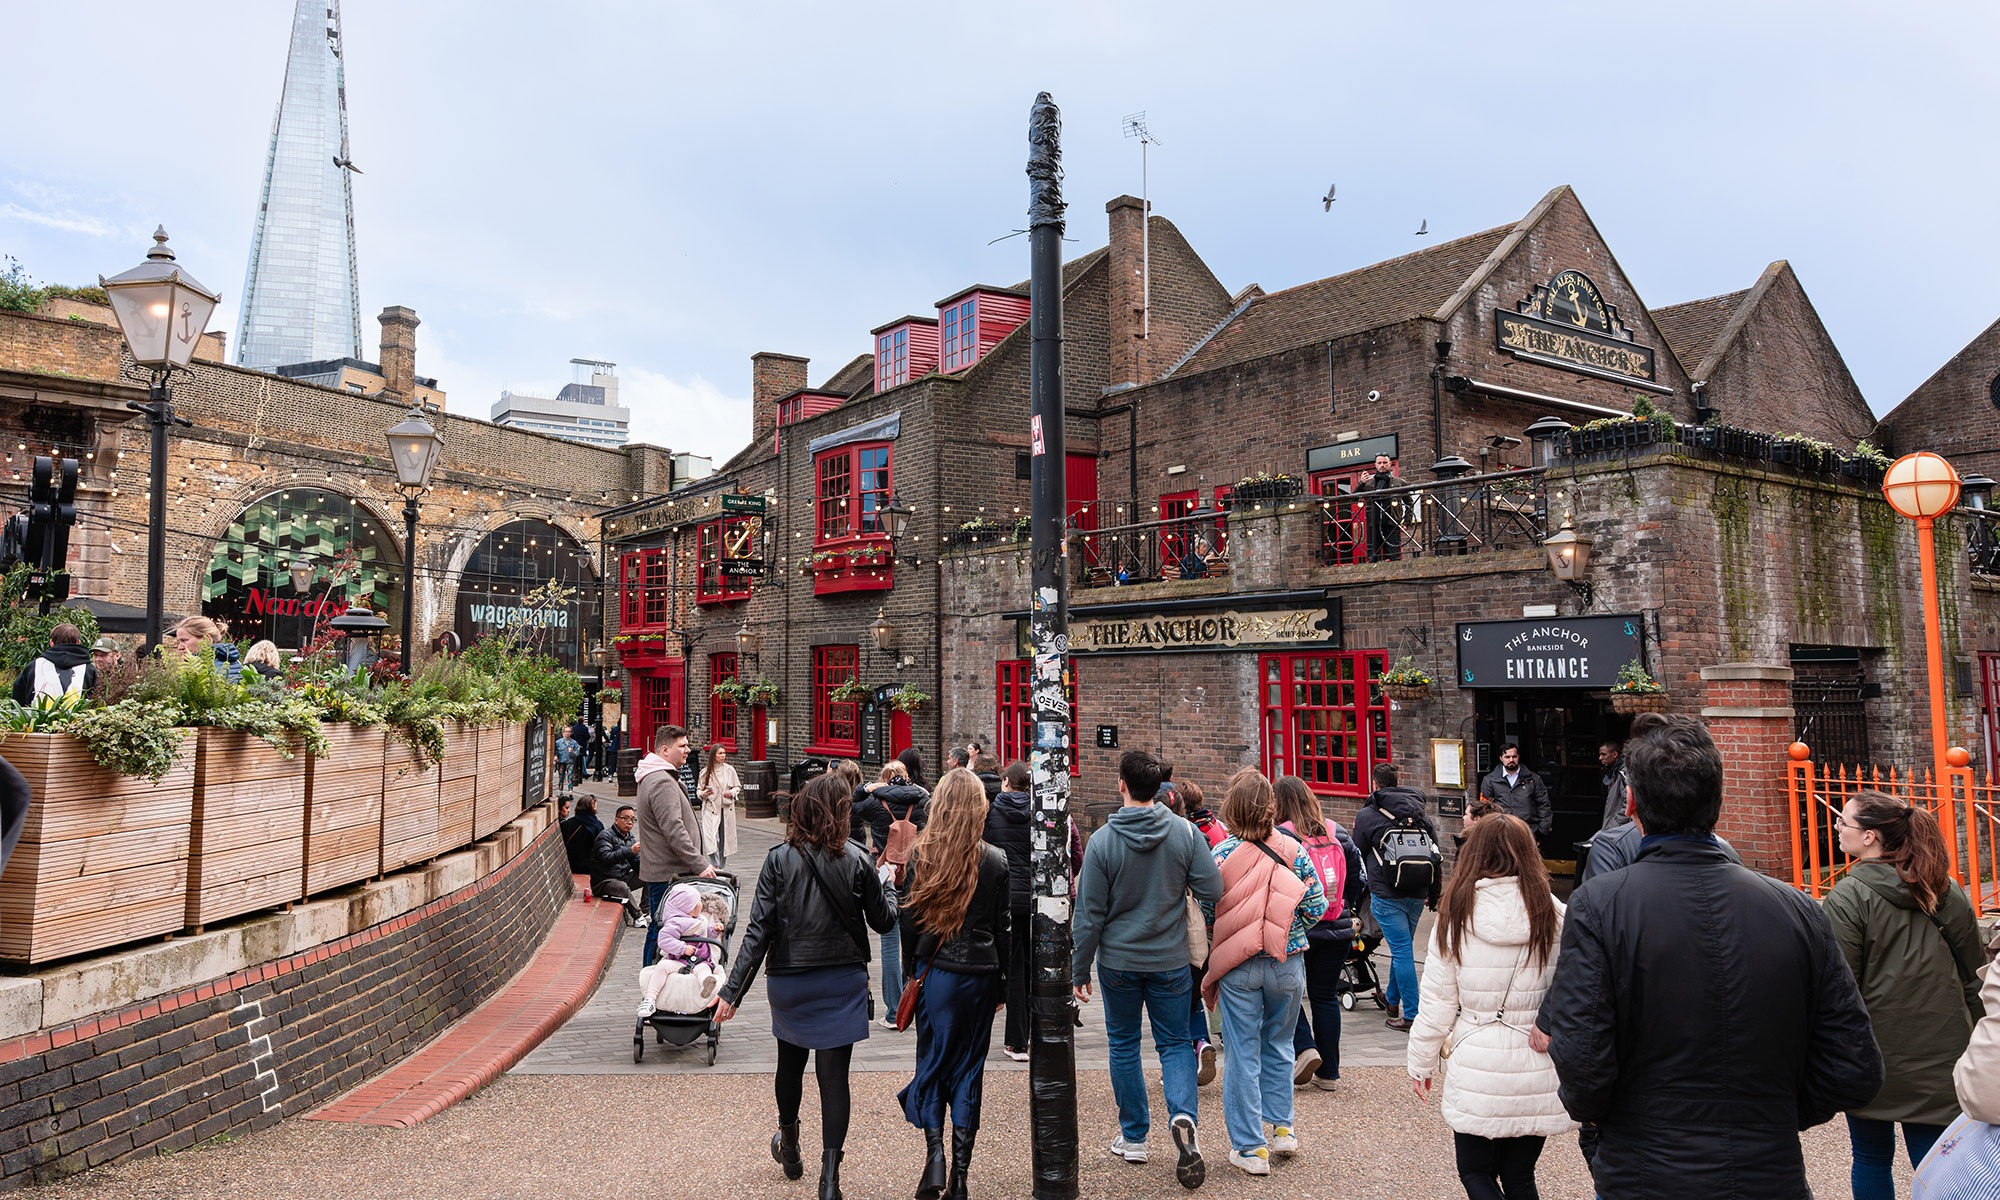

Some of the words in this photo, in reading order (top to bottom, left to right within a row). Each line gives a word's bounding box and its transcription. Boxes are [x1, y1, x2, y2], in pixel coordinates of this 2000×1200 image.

[1546, 287, 1559, 316] REAL
[1556, 273, 1576, 290] ALES,
[1577, 275, 1594, 296] FINE
[1593, 294, 1609, 329] FOOD
[1524, 328, 1559, 353] THE
[1563, 339, 1630, 370] ANCHOR
[1340, 448, 1361, 459] BAR
[633, 514, 652, 530] THE
[655, 503, 696, 524] ANCHOR
[470, 604, 568, 629] wagamama
[1088, 622, 1130, 646] THE
[1136, 616, 1238, 644] ANCHOR
[1504, 632, 1529, 652] THE
[1532, 627, 1589, 649] ANCHOR
[1526, 644, 1564, 652] BANKSIDE
[1506, 657, 1589, 680] ENTRANCE
